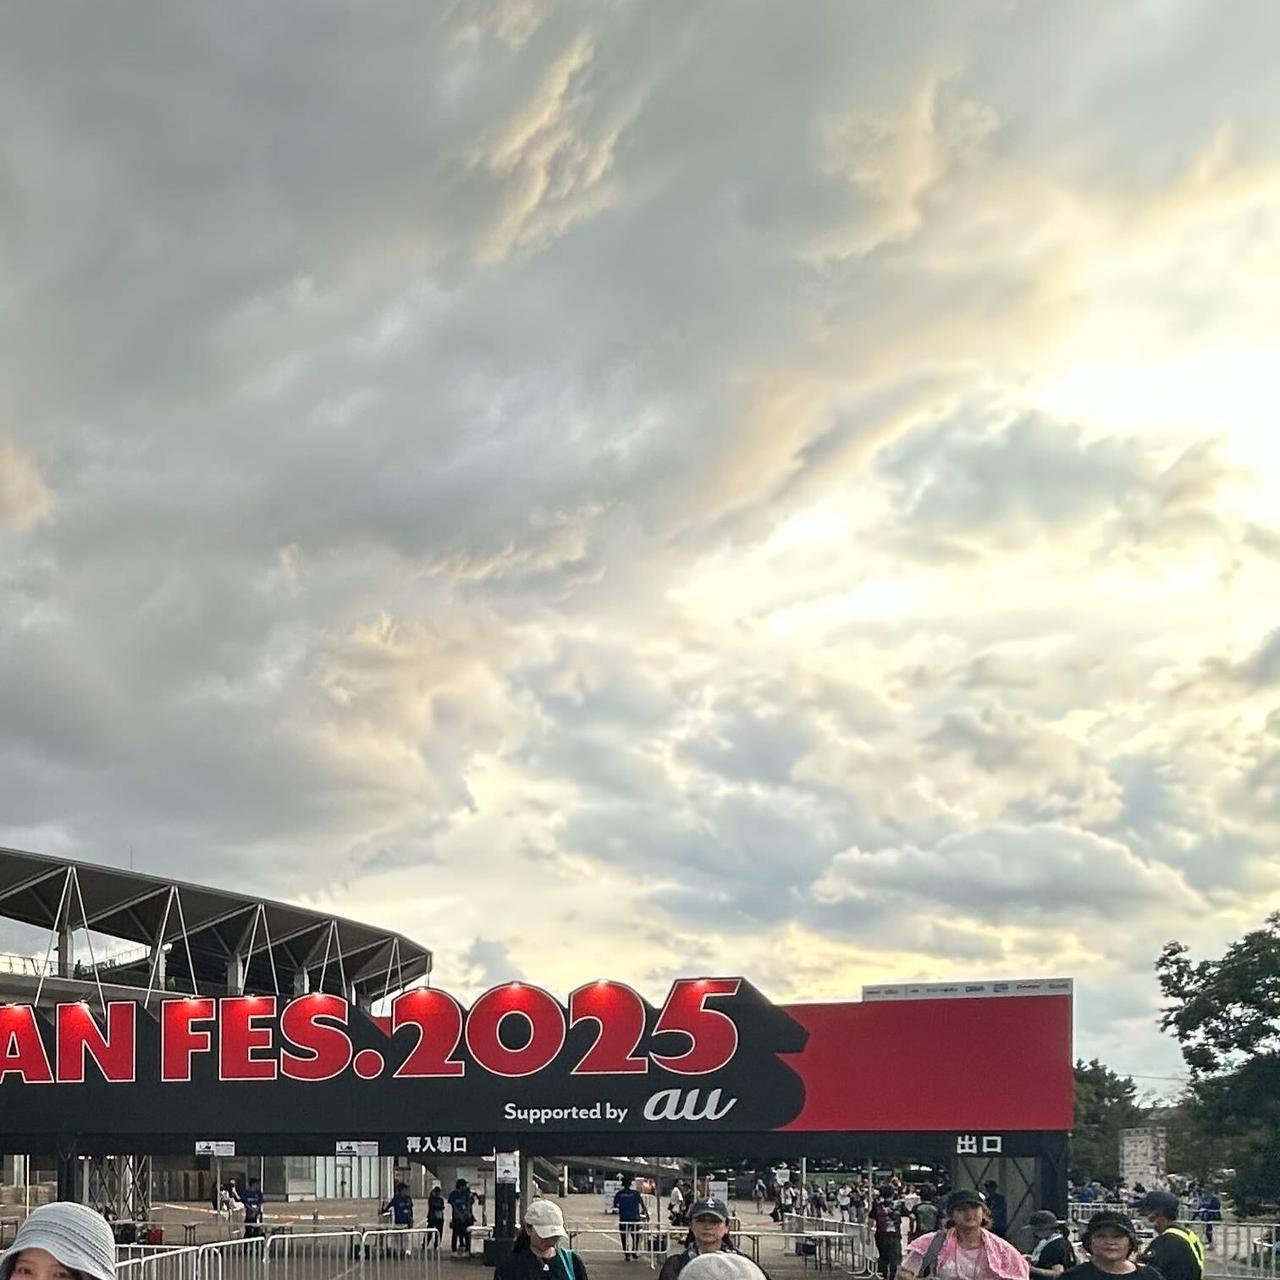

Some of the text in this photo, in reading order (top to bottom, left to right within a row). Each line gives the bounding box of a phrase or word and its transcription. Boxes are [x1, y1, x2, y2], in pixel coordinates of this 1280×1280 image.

[504, 1088, 738, 1124] Supported by au
[406, 1136, 467, 1153] 再入場口
[956, 1134, 1002, 1154] 出口
